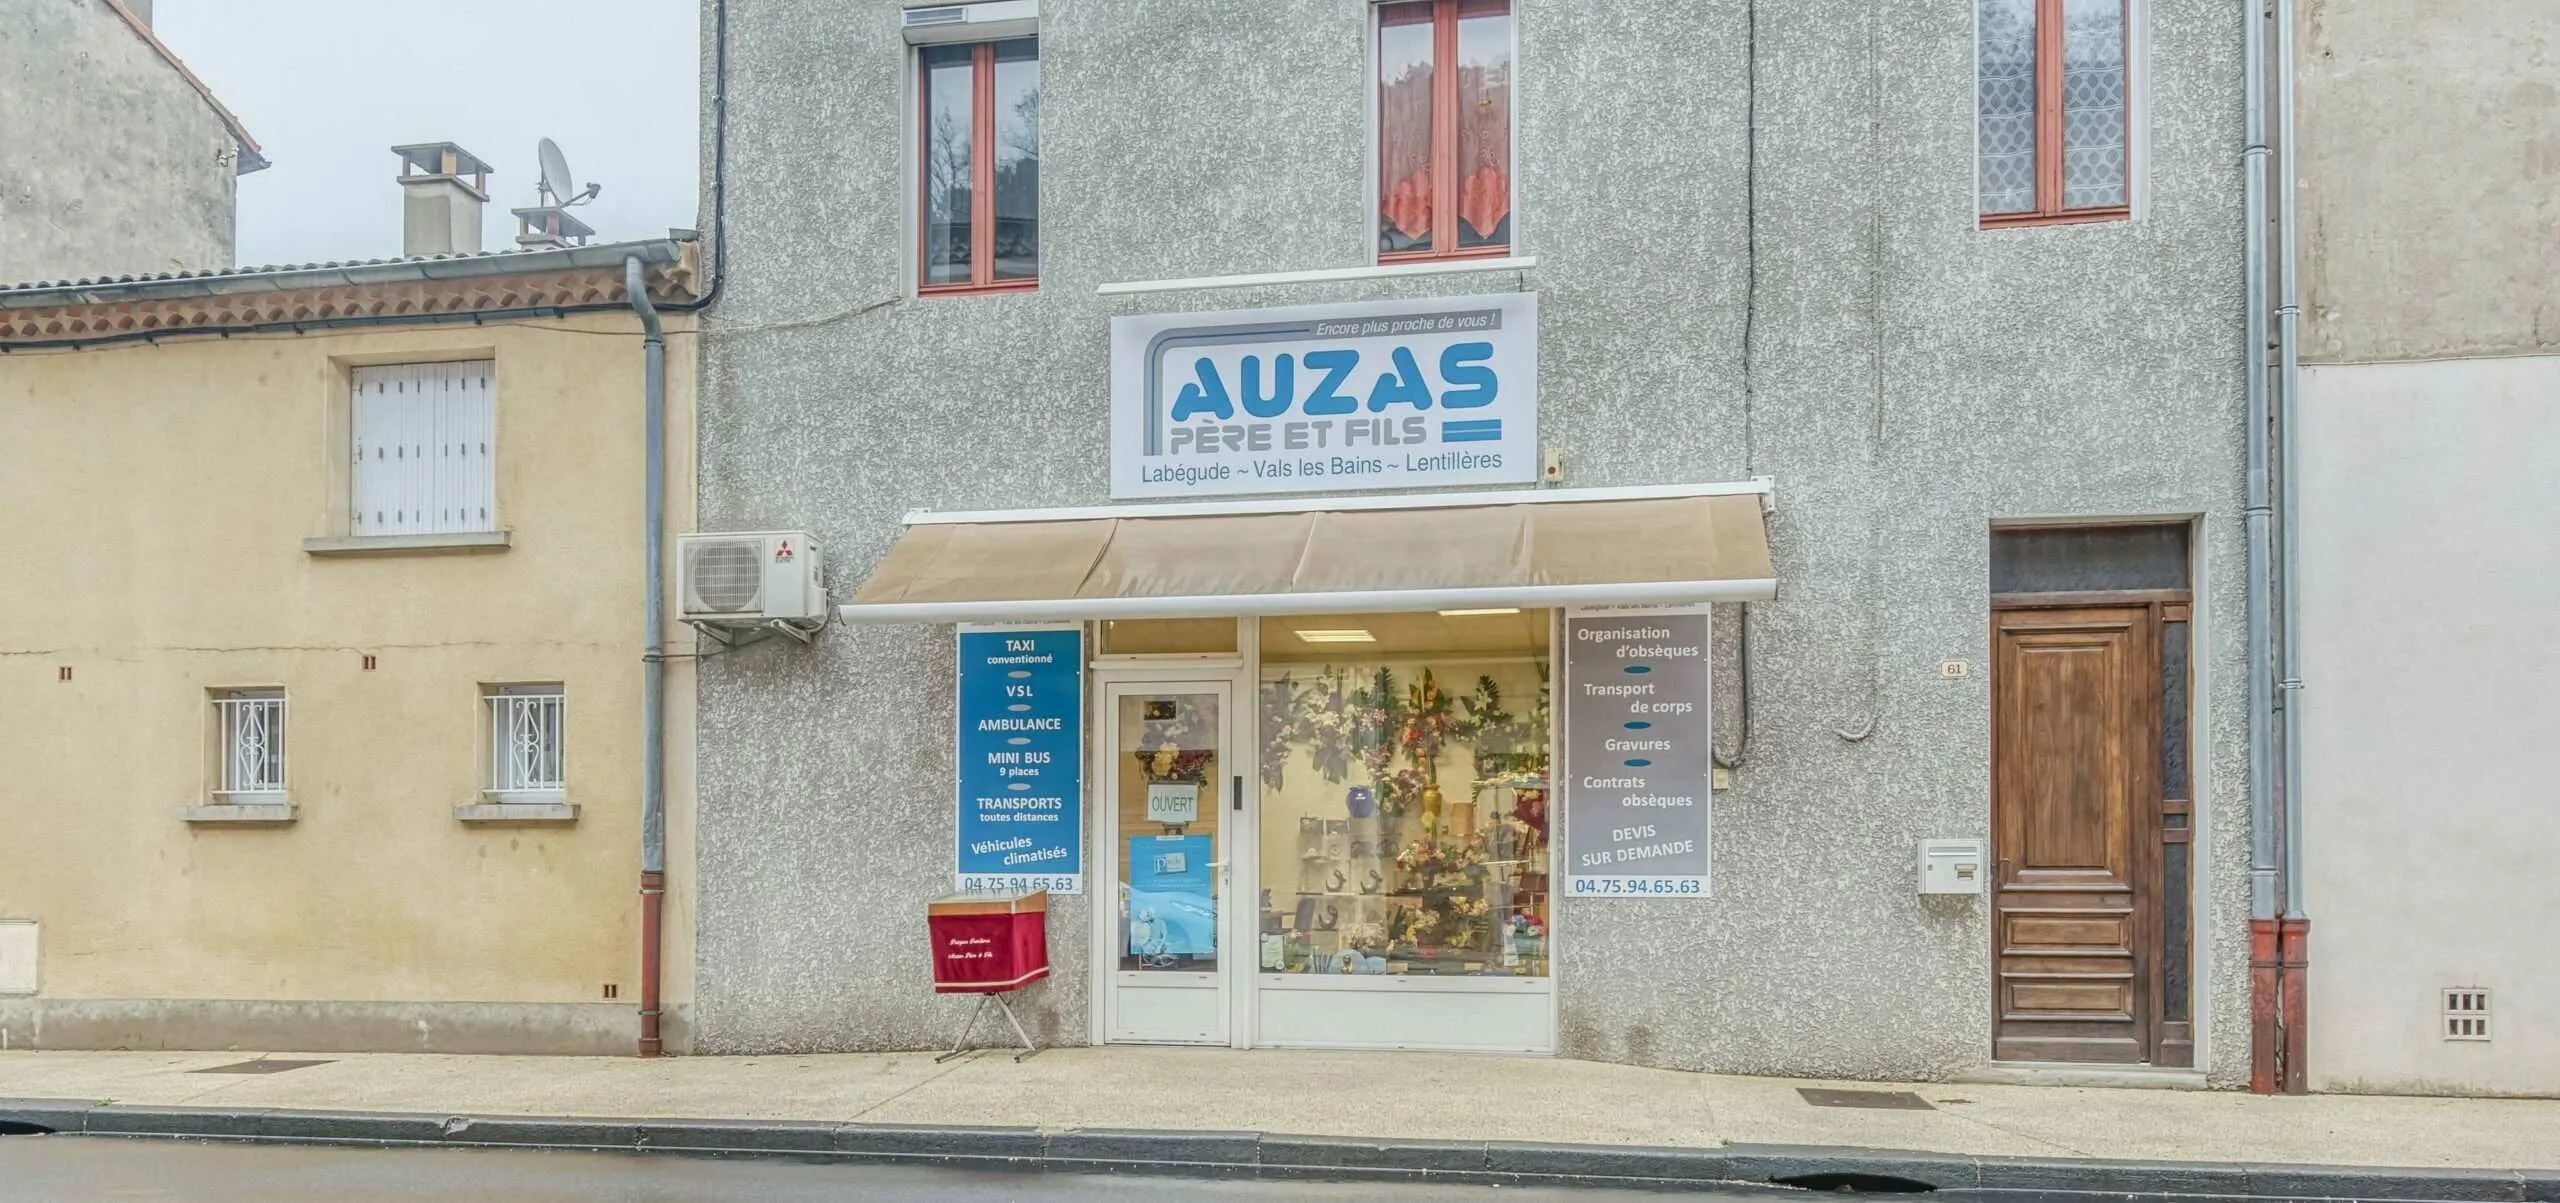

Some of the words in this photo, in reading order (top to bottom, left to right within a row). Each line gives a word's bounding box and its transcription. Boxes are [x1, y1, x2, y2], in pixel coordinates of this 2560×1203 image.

[1316, 322, 1359, 336] Encore
[1361, 320, 1389, 336] plus
[1391, 317, 1433, 334] proche
[1438, 315, 1453, 329] de
[1458, 315, 1487, 328] vous
[1170, 341, 1499, 423] AUZAS
[1170, 418, 1272, 455] PÈRE
[1284, 420, 1333, 450] ET
[1345, 416, 1428, 447] FILS
[1142, 462, 1230, 486] Labégude
[1253, 459, 1293, 478] Vals
[1299, 457, 1325, 477] les
[1331, 455, 1383, 475] Bains
[1406, 450, 1502, 472] Lentillères
[1577, 627, 1670, 643] Organisation
[1005, 639, 1035, 652] TAXI
[1616, 644, 1699, 659] d'obsèques
[986, 653, 1053, 665] conventionné
[1947, 663, 1961, 674] 61
[1006, 685, 1034, 697] VSL
[1584, 683, 1655, 697] Transport
[1630, 700, 1648, 713] de
[1652, 702, 1693, 715] corps
[978, 718, 1062, 731] AMBULANCE
[1605, 738, 1671, 751] Gravures
[988, 752, 1019, 764] MINI
[1024, 751, 1051, 764] BUS
[999, 767, 1006, 776] 9
[1008, 767, 1040, 778] places
[1583, 776, 1646, 789] Contrats
[976, 797, 1062, 810] TRANSPORTS
[1151, 796, 1194, 812] OUVERT
[1622, 793, 1693, 808] obsèques
[980, 812, 1011, 822] toutes
[1013, 812, 1059, 822] distances
[1612, 824, 1656, 842] DEVIS
[970, 836, 1032, 854] Véhicules
[1003, 846, 1067, 866] climatisés
[1582, 851, 1612, 867] SUR
[1617, 840, 1694, 862] DEMANDE
[1575, 879, 1700, 894] 04.75.94.65.63
